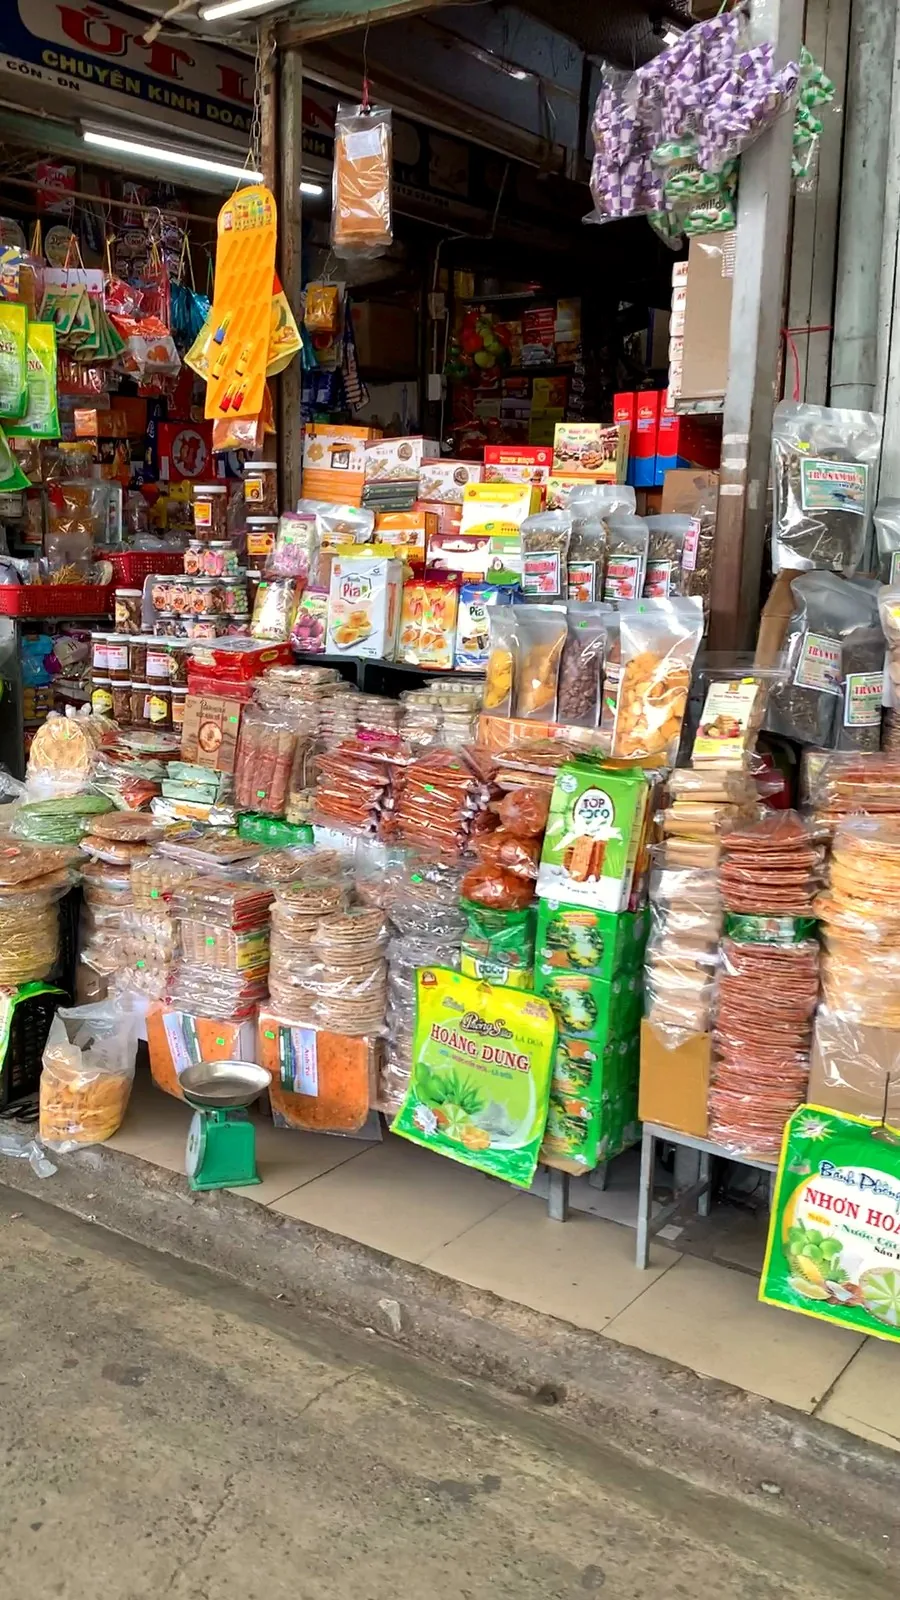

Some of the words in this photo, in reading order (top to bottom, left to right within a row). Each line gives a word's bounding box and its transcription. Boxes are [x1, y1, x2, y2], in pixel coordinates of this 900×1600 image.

[42, 49, 141, 94] CHUYÊN
[148, 83, 200, 114] KINH
[583, 798, 605, 809] TOP
[481, 1044, 530, 1071] DUNG
[820, 1161, 856, 1185] Bánh
[803, 1187, 861, 1220] NHƠN
